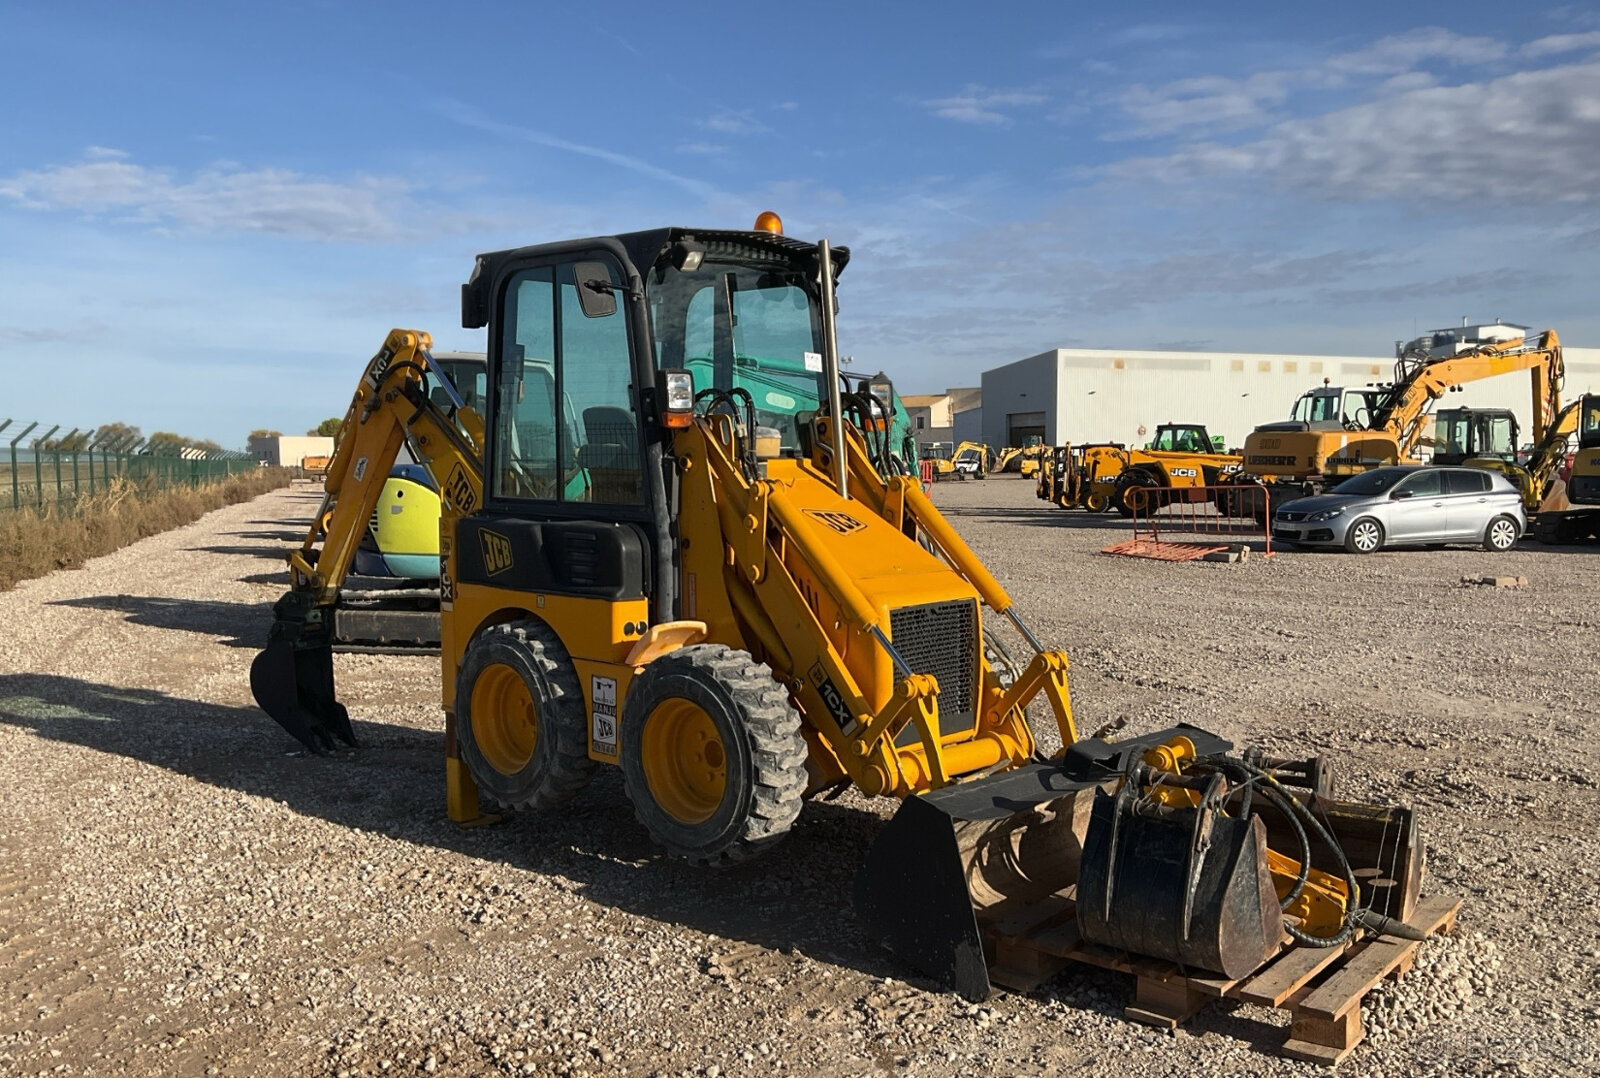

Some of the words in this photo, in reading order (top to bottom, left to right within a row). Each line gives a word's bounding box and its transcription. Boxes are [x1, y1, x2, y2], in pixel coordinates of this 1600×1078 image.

[1170, 467, 1198, 477] JCB
[445, 470, 475, 513] JCB
[811, 511, 862, 534] JCB
[484, 532, 511, 572] JCB
[823, 683, 850, 724] 1CX
[598, 719, 613, 737] JCB
